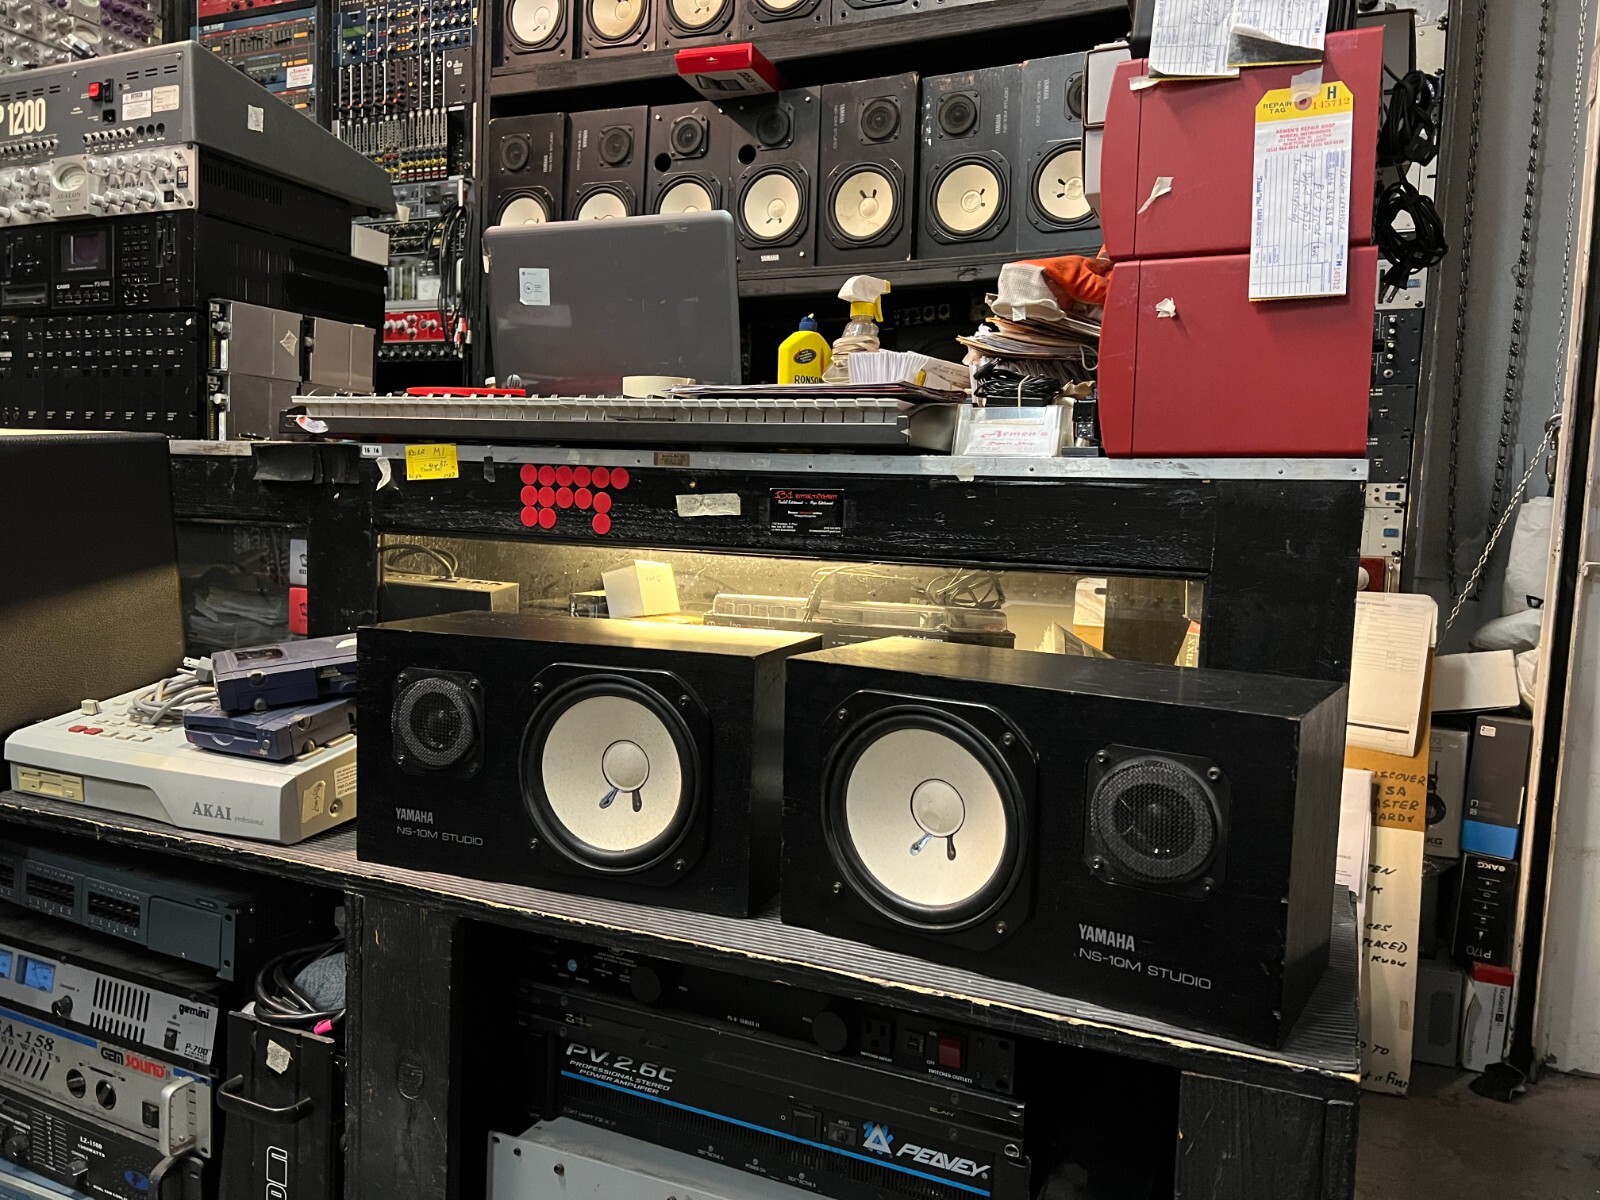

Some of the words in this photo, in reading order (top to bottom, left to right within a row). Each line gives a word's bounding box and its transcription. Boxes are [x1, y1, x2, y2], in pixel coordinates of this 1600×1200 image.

[1327, 85, 1337, 100] H
[1263, 101, 1292, 109] REPAIR
[1313, 97, 1350, 110] 145712
[8, 98, 46, 136] 1200
[1333, 267, 1341, 290] 145712
[191, 801, 232, 821] AKAI
[234, 815, 264, 826] professional
[395, 807, 434, 825] YAMAHA
[396, 826, 438, 840] NS-10M
[441, 832, 484, 846] STUDIO
[1476, 860, 1499, 871] AKG
[1078, 923, 1135, 952] YAMAHA
[1465, 944, 1493, 959] P170
[1079, 947, 1142, 973] NS-10M
[1147, 965, 1211, 990] STUDIO
[1498, 987, 1506, 1013] Scarlett
[179, 1004, 209, 1019] gemini
[20, 1042, 61, 1063] WATTS
[185, 1043, 208, 1056] P-700
[569, 1060, 634, 1084] PROFESSIONAL
[635, 1078, 670, 1093] STEREO
[579, 1068, 613, 1084] POWER
[613, 1079, 660, 1095] AMPLIFIER
[928, 1068, 951, 1079] SWITCHED
[952, 1073, 973, 1084] OUTLETS
[896, 1143, 986, 1177] PEAVEY
